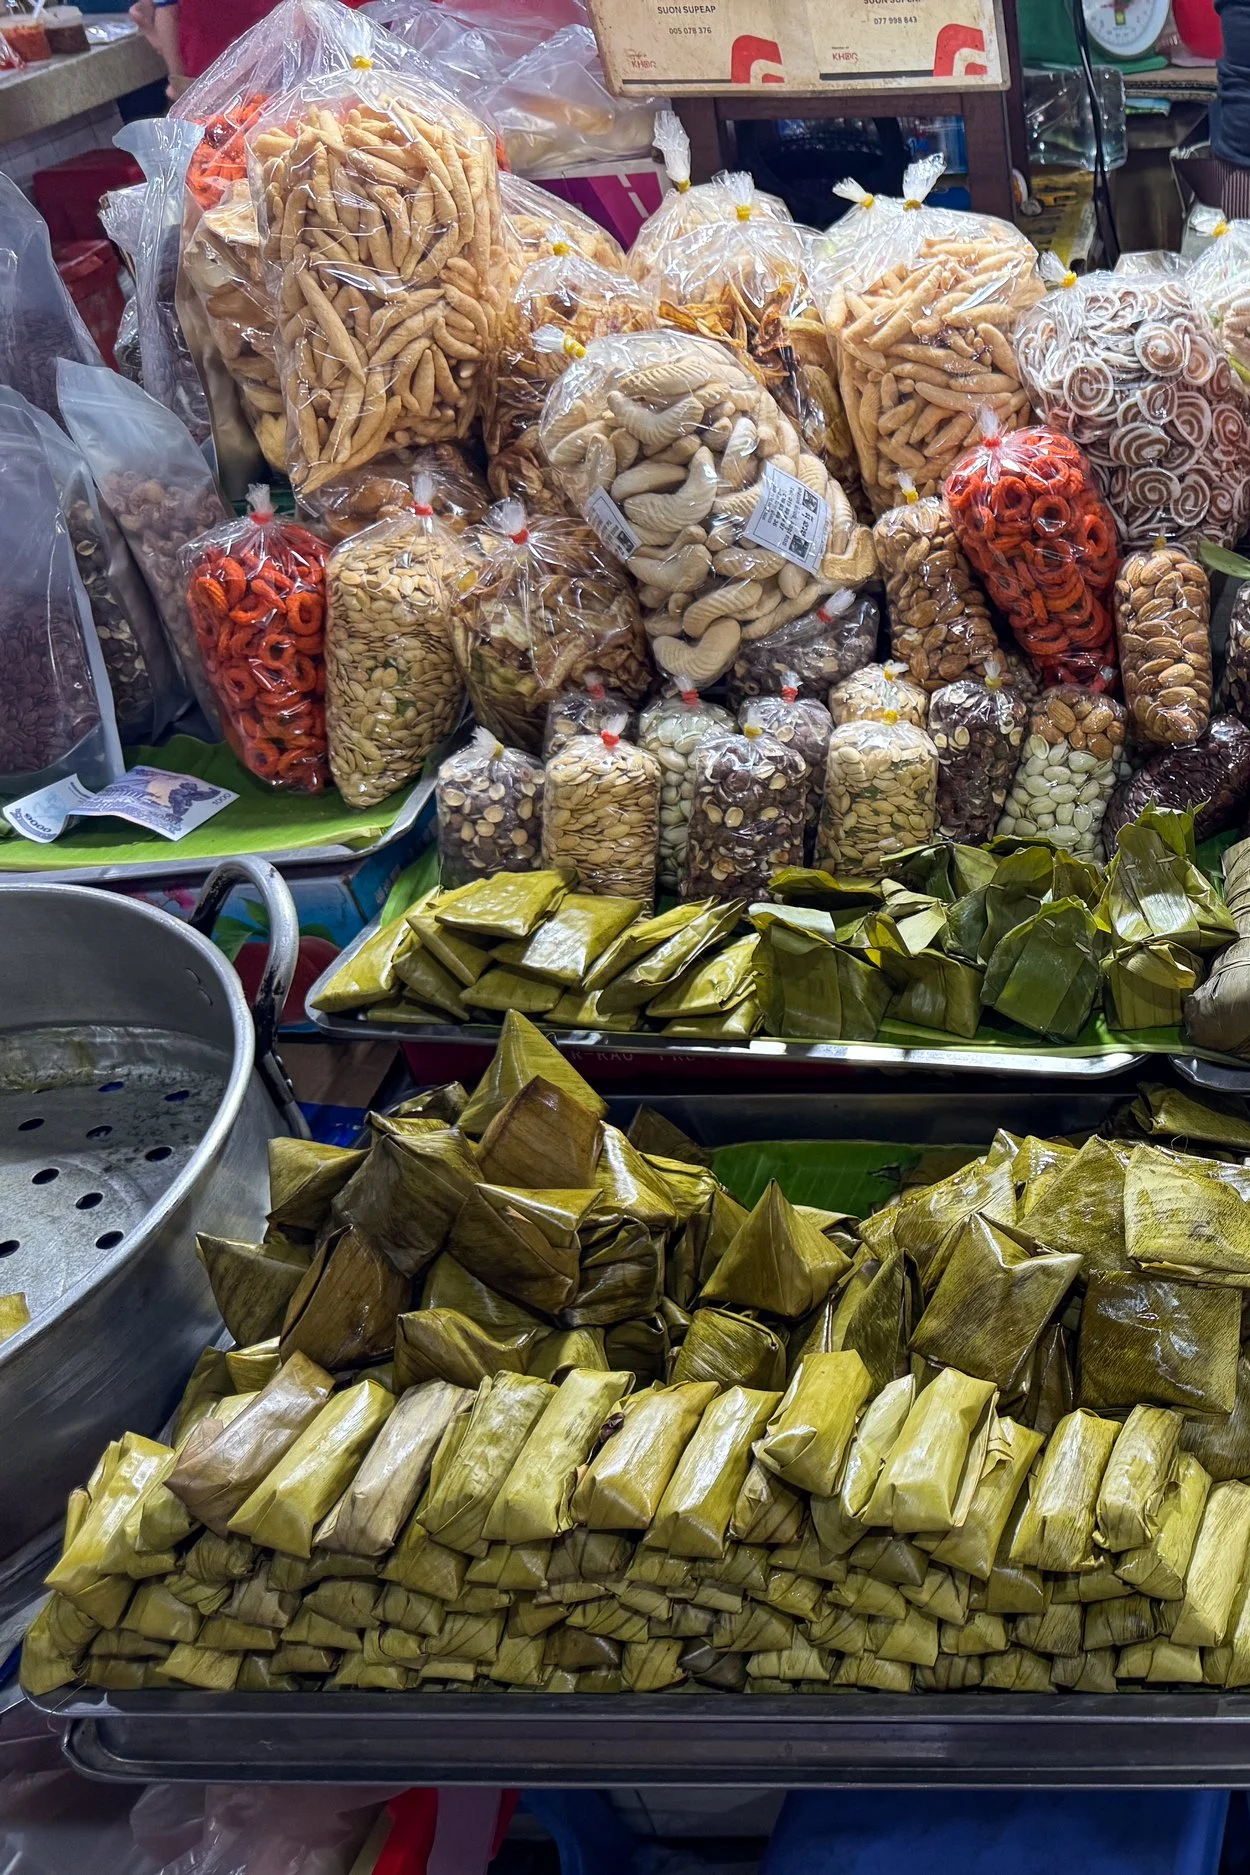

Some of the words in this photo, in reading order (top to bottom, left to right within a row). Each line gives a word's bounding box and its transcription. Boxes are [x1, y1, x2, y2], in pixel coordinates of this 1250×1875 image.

[657, 5, 682, 15] SUON
[683, 5, 716, 14] SUPEAP
[873, 17, 887, 25] 077
[888, 16, 902, 24] 998
[903, 15, 918, 24] 843
[669, 27, 683, 35] 005
[684, 27, 697, 35] 078
[698, 26, 712, 34] 376
[212, 792, 232, 806] 1000
